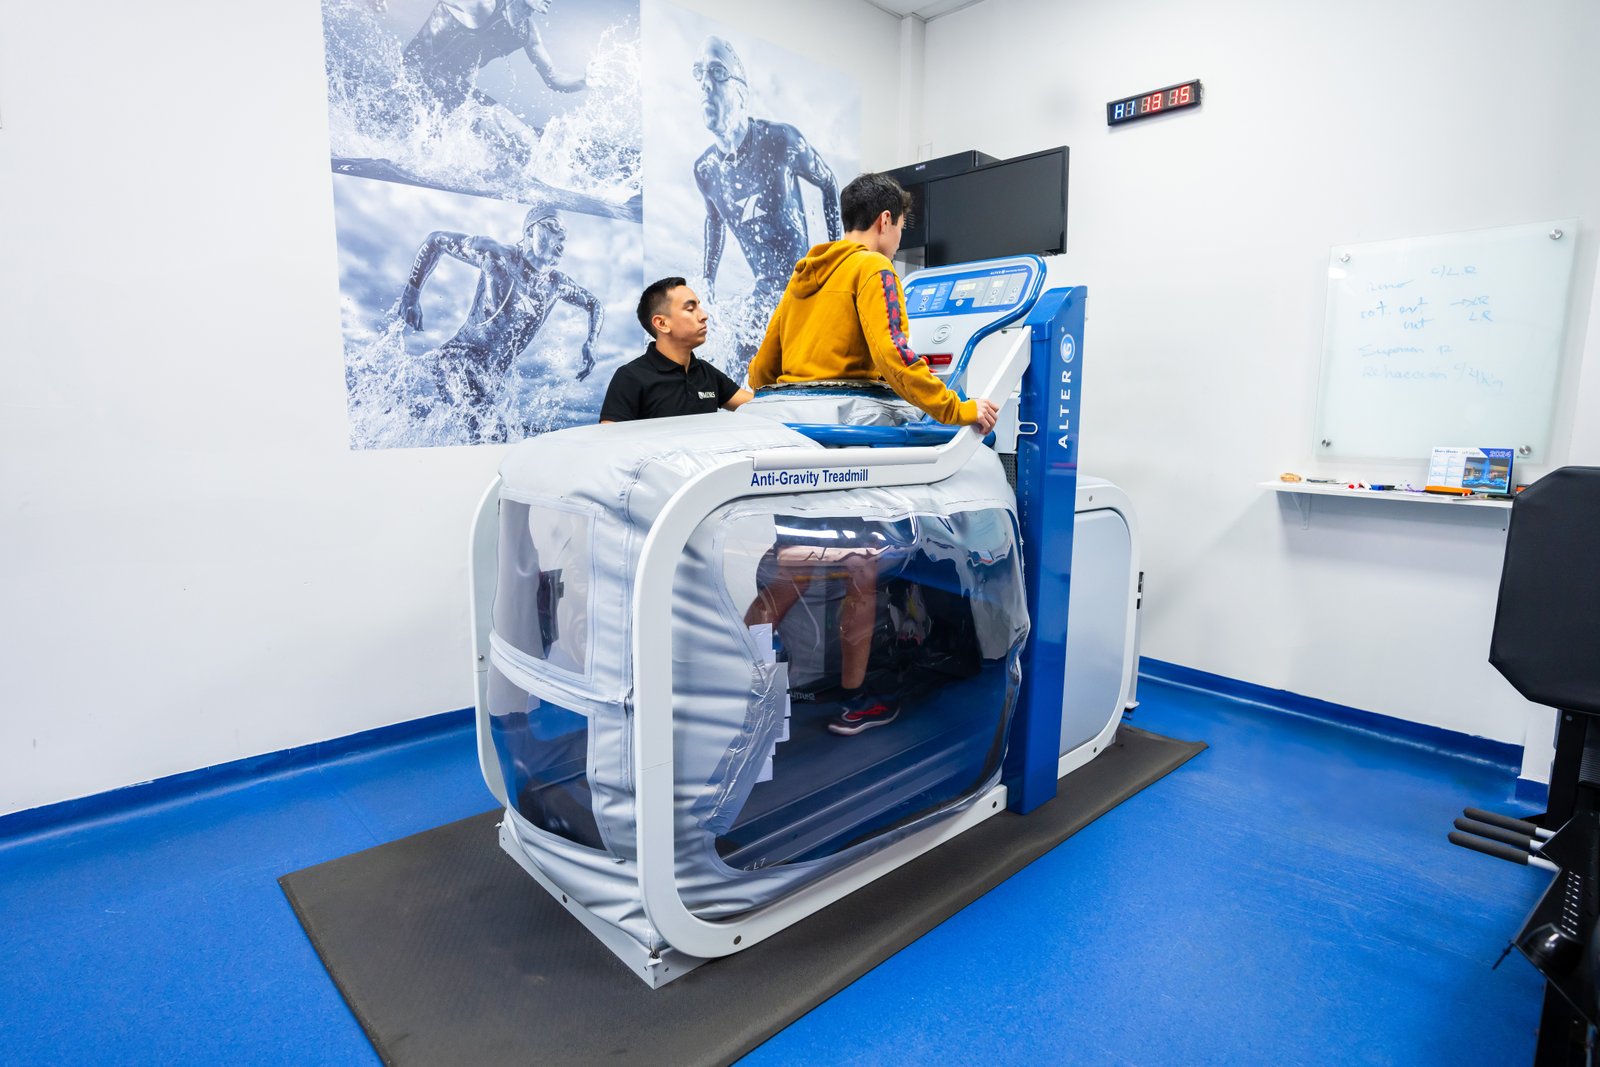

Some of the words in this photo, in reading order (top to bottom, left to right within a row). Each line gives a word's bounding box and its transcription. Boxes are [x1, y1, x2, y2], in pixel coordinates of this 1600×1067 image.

[1145, 92, 1162, 113] 13
[1172, 85, 1190, 104] 15
[1489, 450, 1512, 458] 2024
[750, 471, 819, 487] Anti-Gravity
[822, 469, 869, 483] Treadmill
